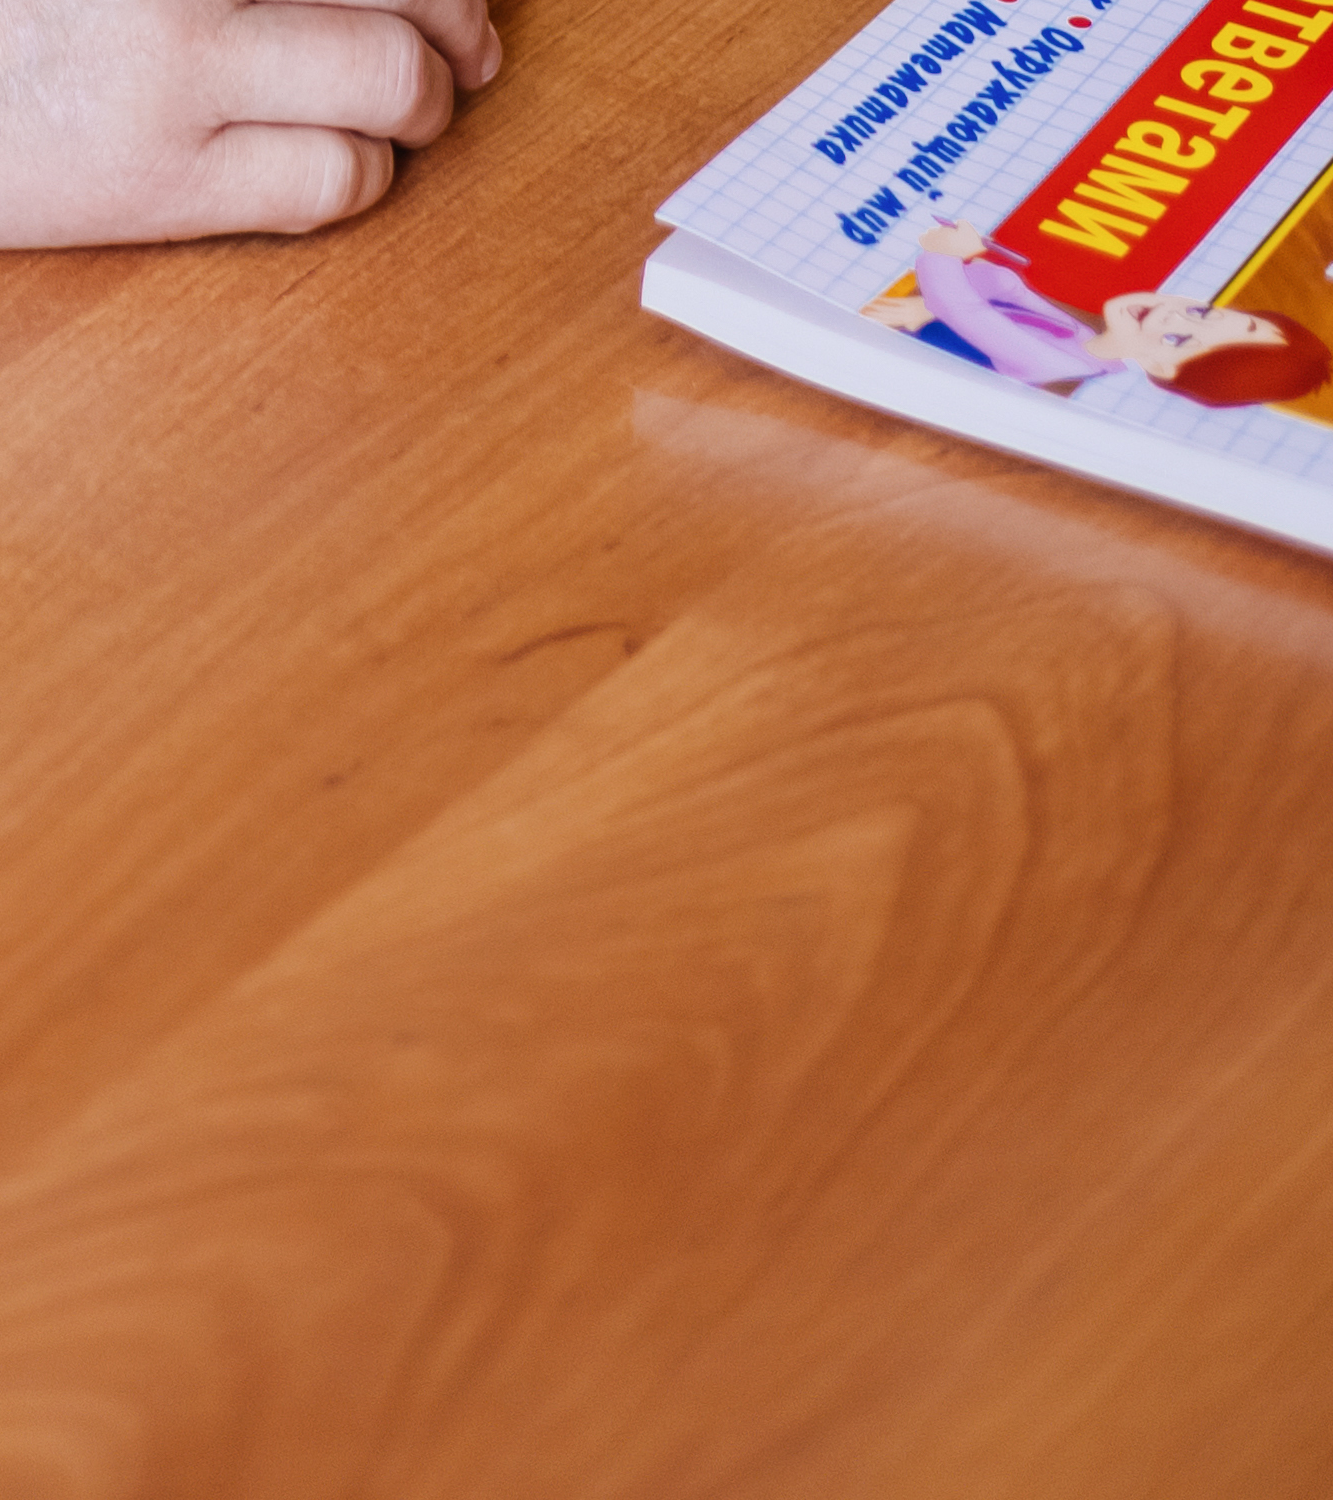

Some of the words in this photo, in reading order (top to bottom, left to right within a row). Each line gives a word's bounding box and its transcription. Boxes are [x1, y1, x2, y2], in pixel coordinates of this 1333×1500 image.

[811, 0, 1009, 166] Математика
[896, 26, 1085, 201] Окружающий
[836, 186, 907, 247] мир
